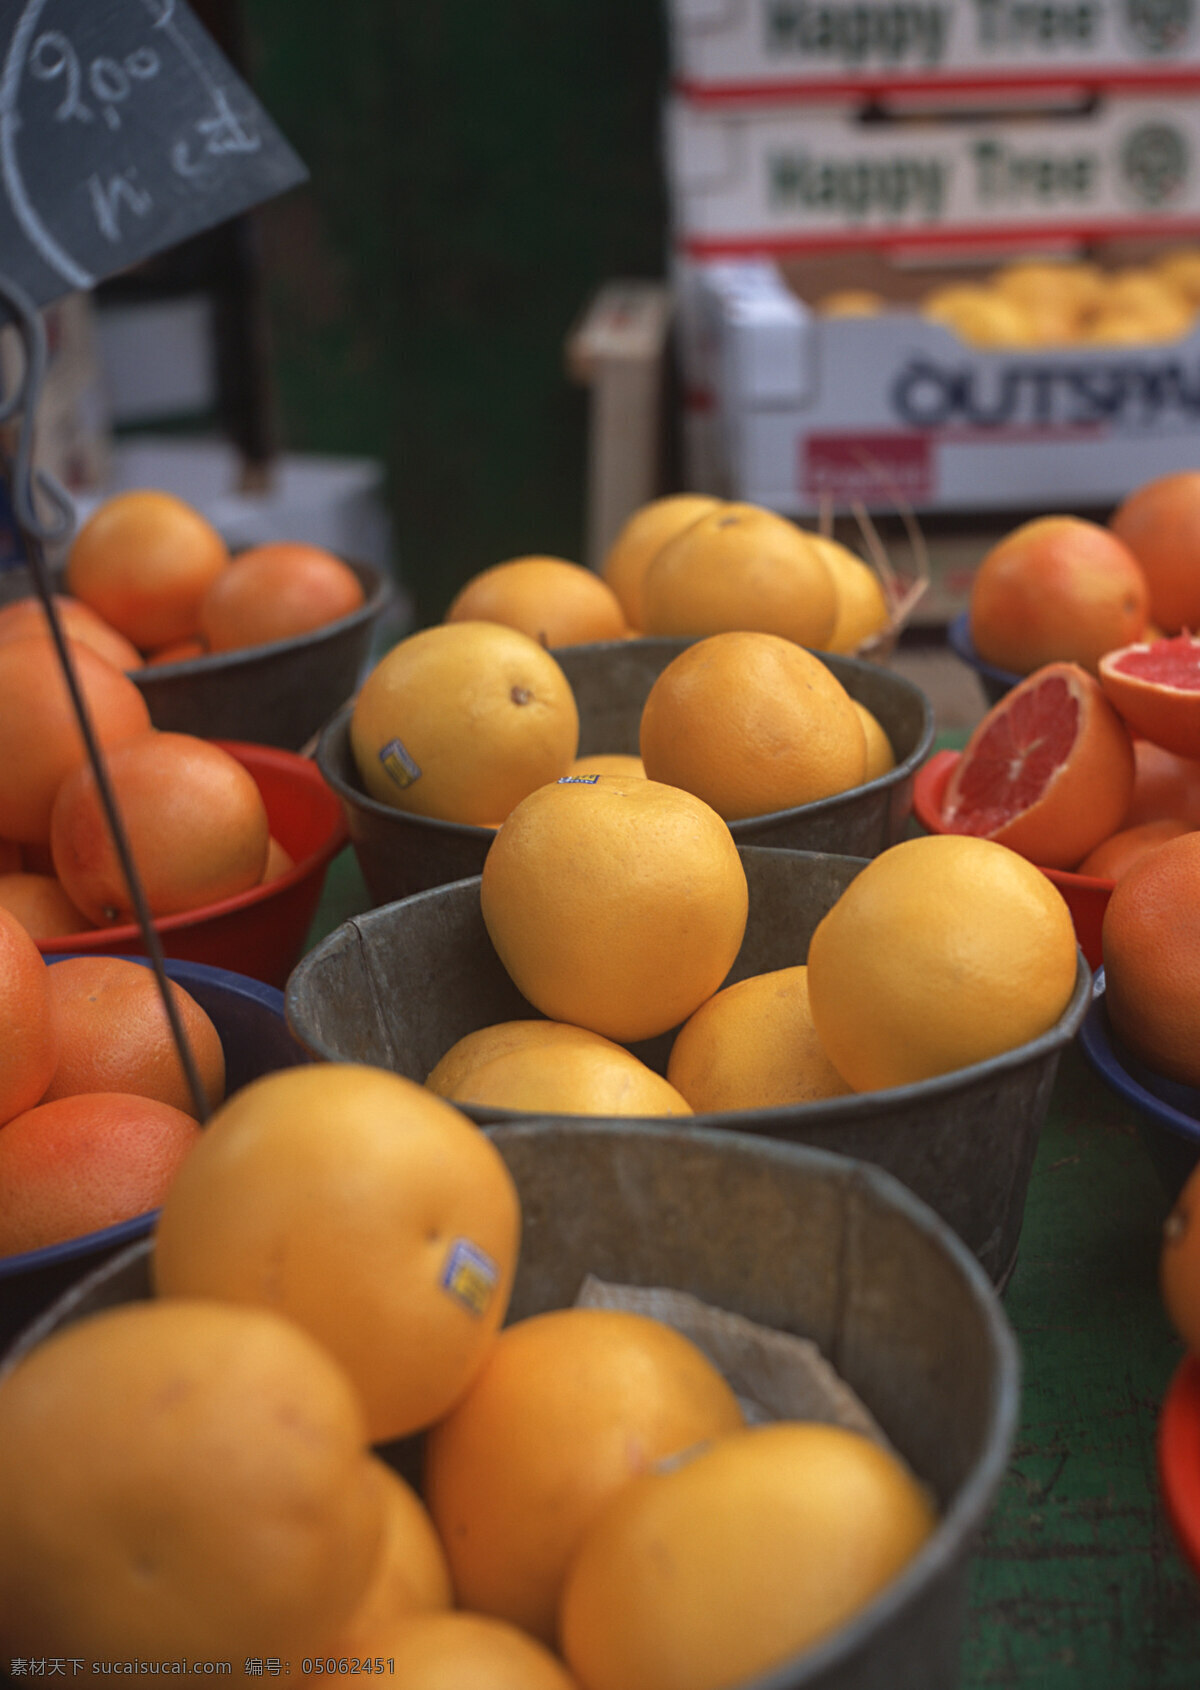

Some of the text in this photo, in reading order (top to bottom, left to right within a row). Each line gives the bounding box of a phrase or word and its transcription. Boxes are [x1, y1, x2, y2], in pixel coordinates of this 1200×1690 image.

[766, 0, 1098, 68] Happy Tree
[766, 137, 1098, 226] Happy Tree
